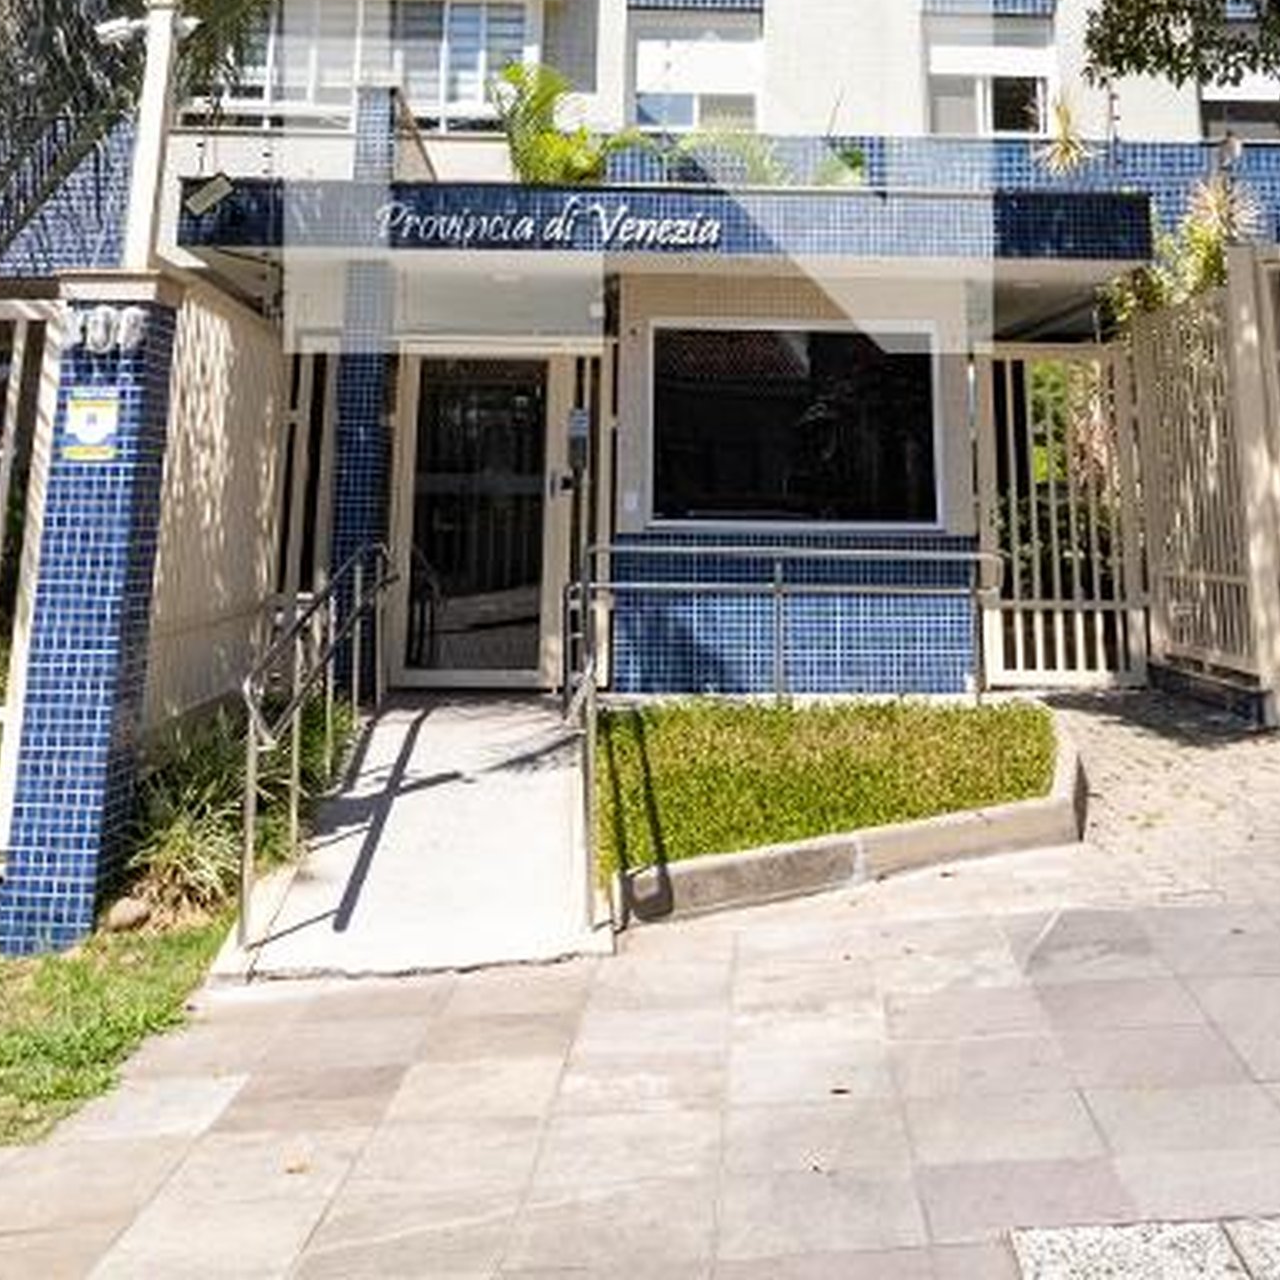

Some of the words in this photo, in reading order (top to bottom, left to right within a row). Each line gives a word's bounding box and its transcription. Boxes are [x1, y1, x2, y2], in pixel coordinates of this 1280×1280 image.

[375, 200, 534, 244] Provincia
[543, 196, 579, 241] di
[588, 202, 720, 245] Venezia
